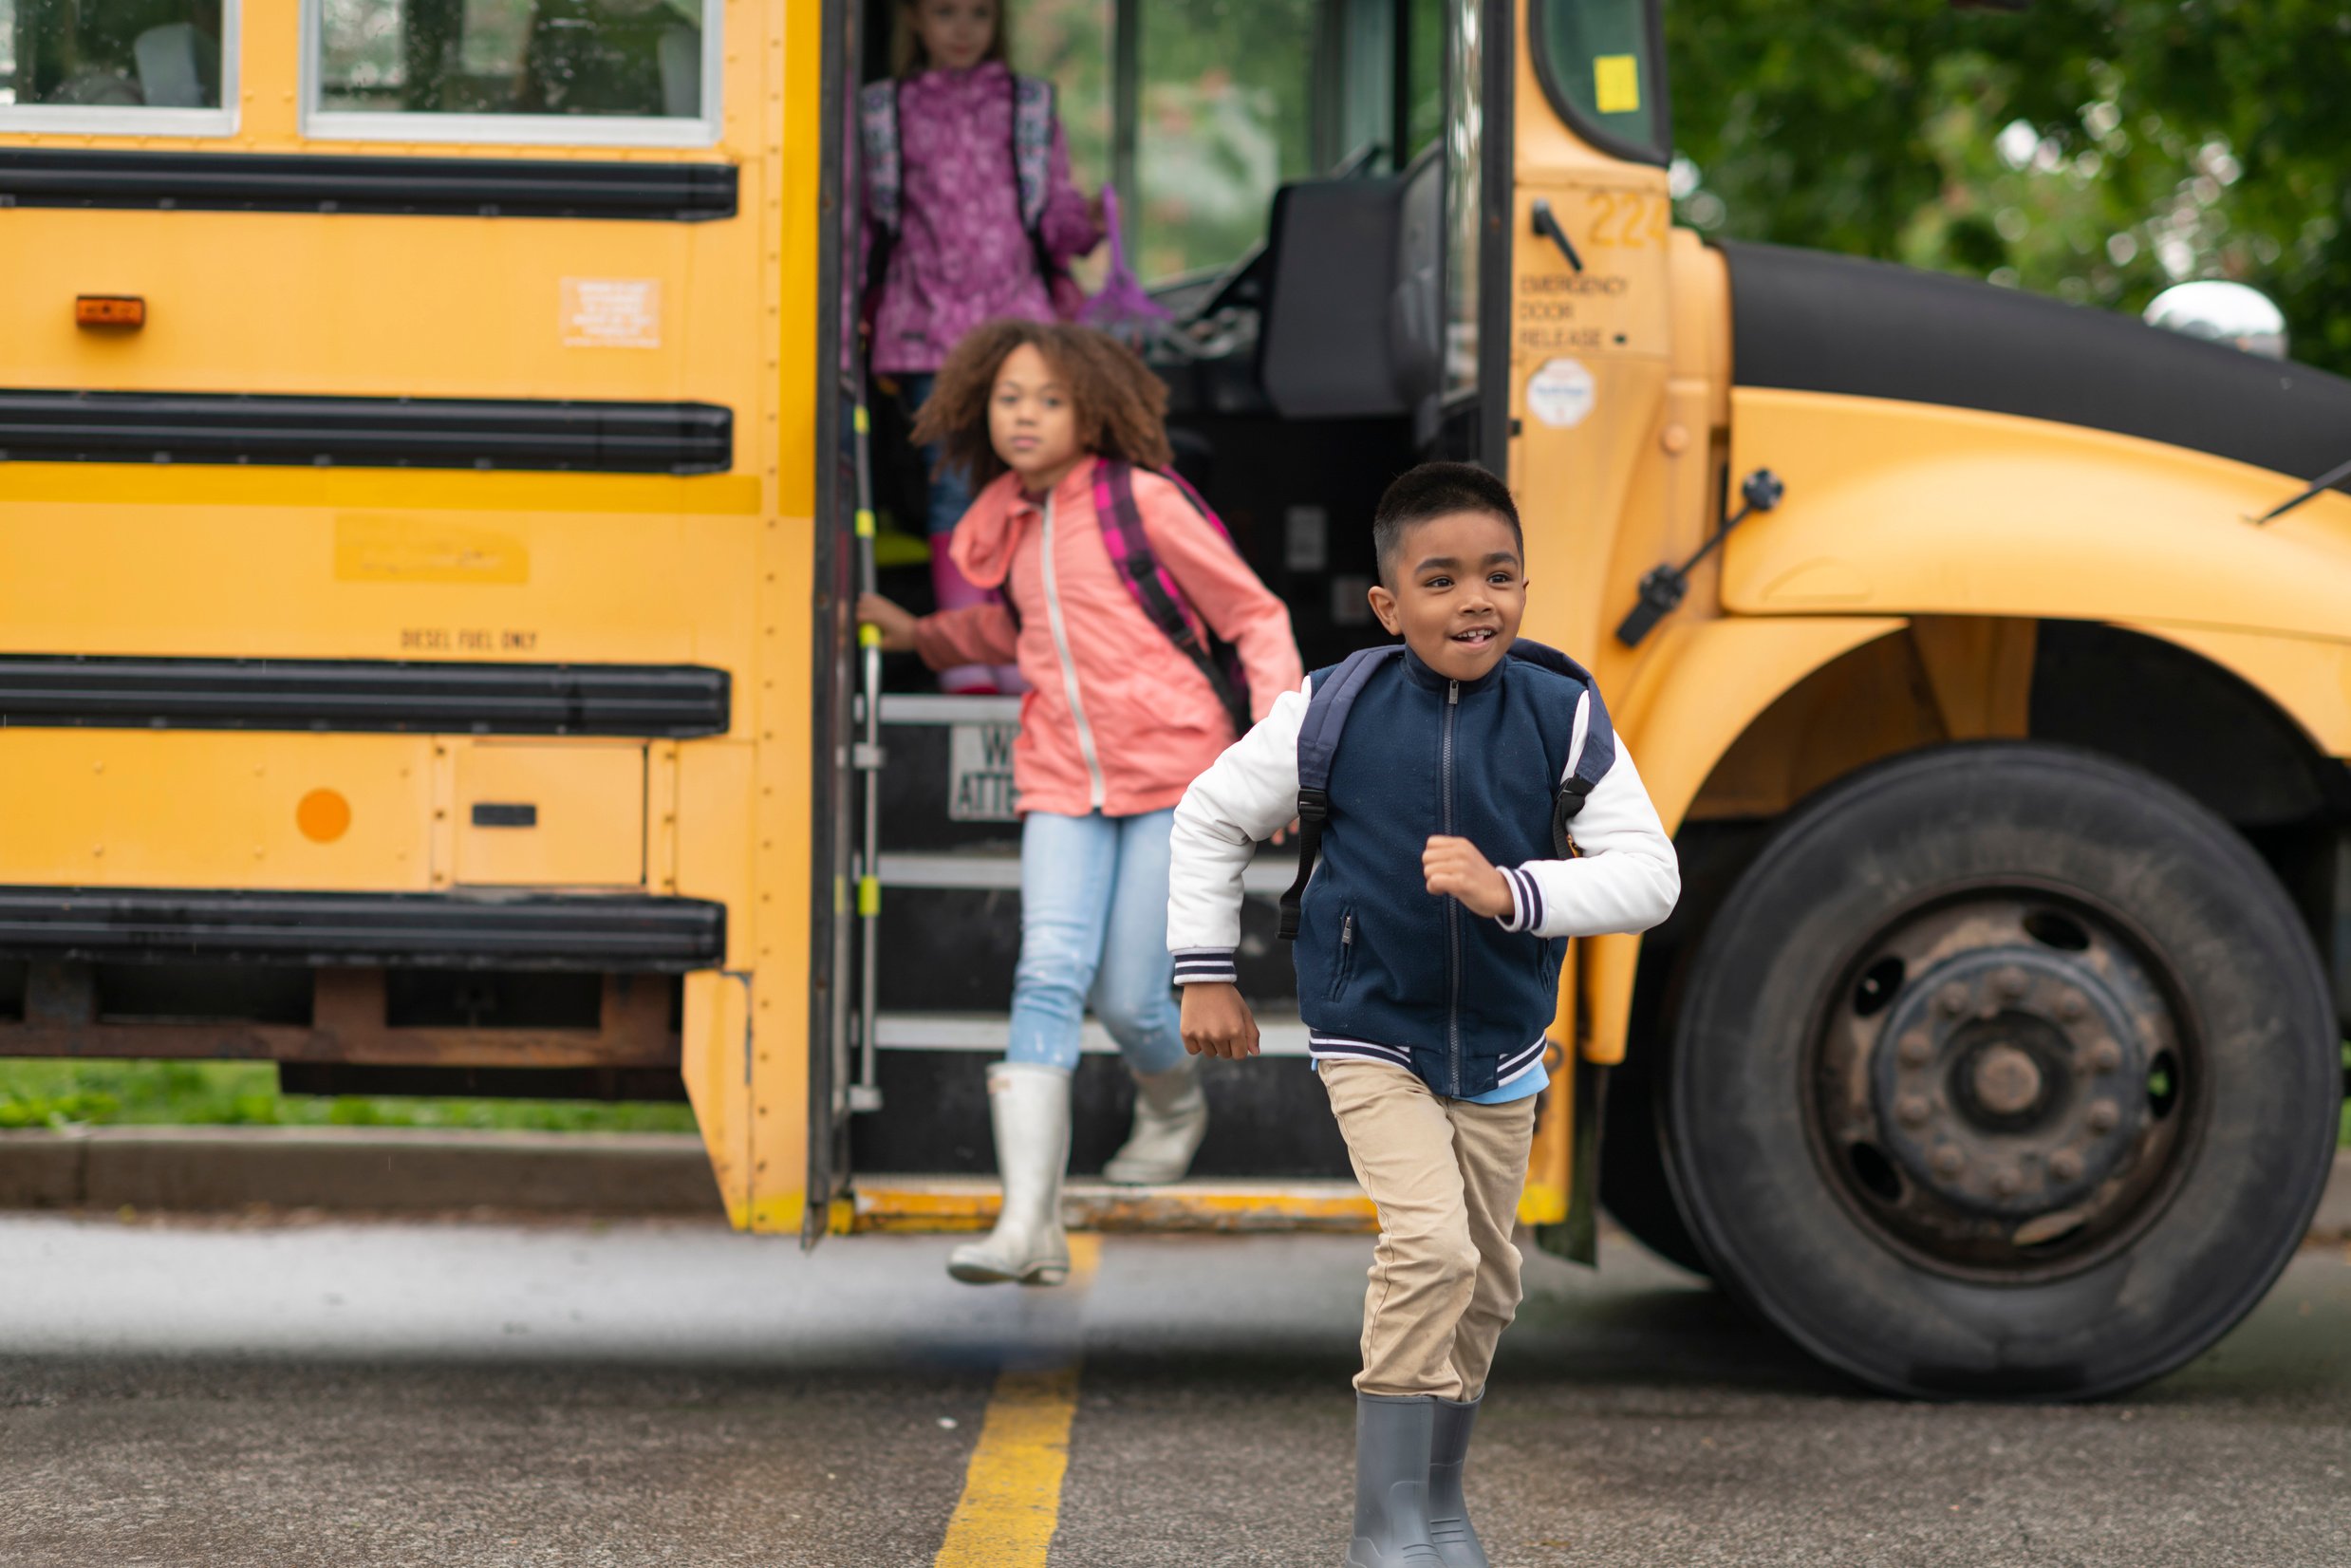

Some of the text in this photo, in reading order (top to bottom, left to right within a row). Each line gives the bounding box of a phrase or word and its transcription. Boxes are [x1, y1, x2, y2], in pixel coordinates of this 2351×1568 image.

[1520, 275, 1628, 296] EMERGENCY
[1520, 301, 1573, 321] DOOR
[1520, 327, 1601, 348] RELEASE
[401, 628, 450, 649] DIESEL
[501, 629, 537, 650] ONLY
